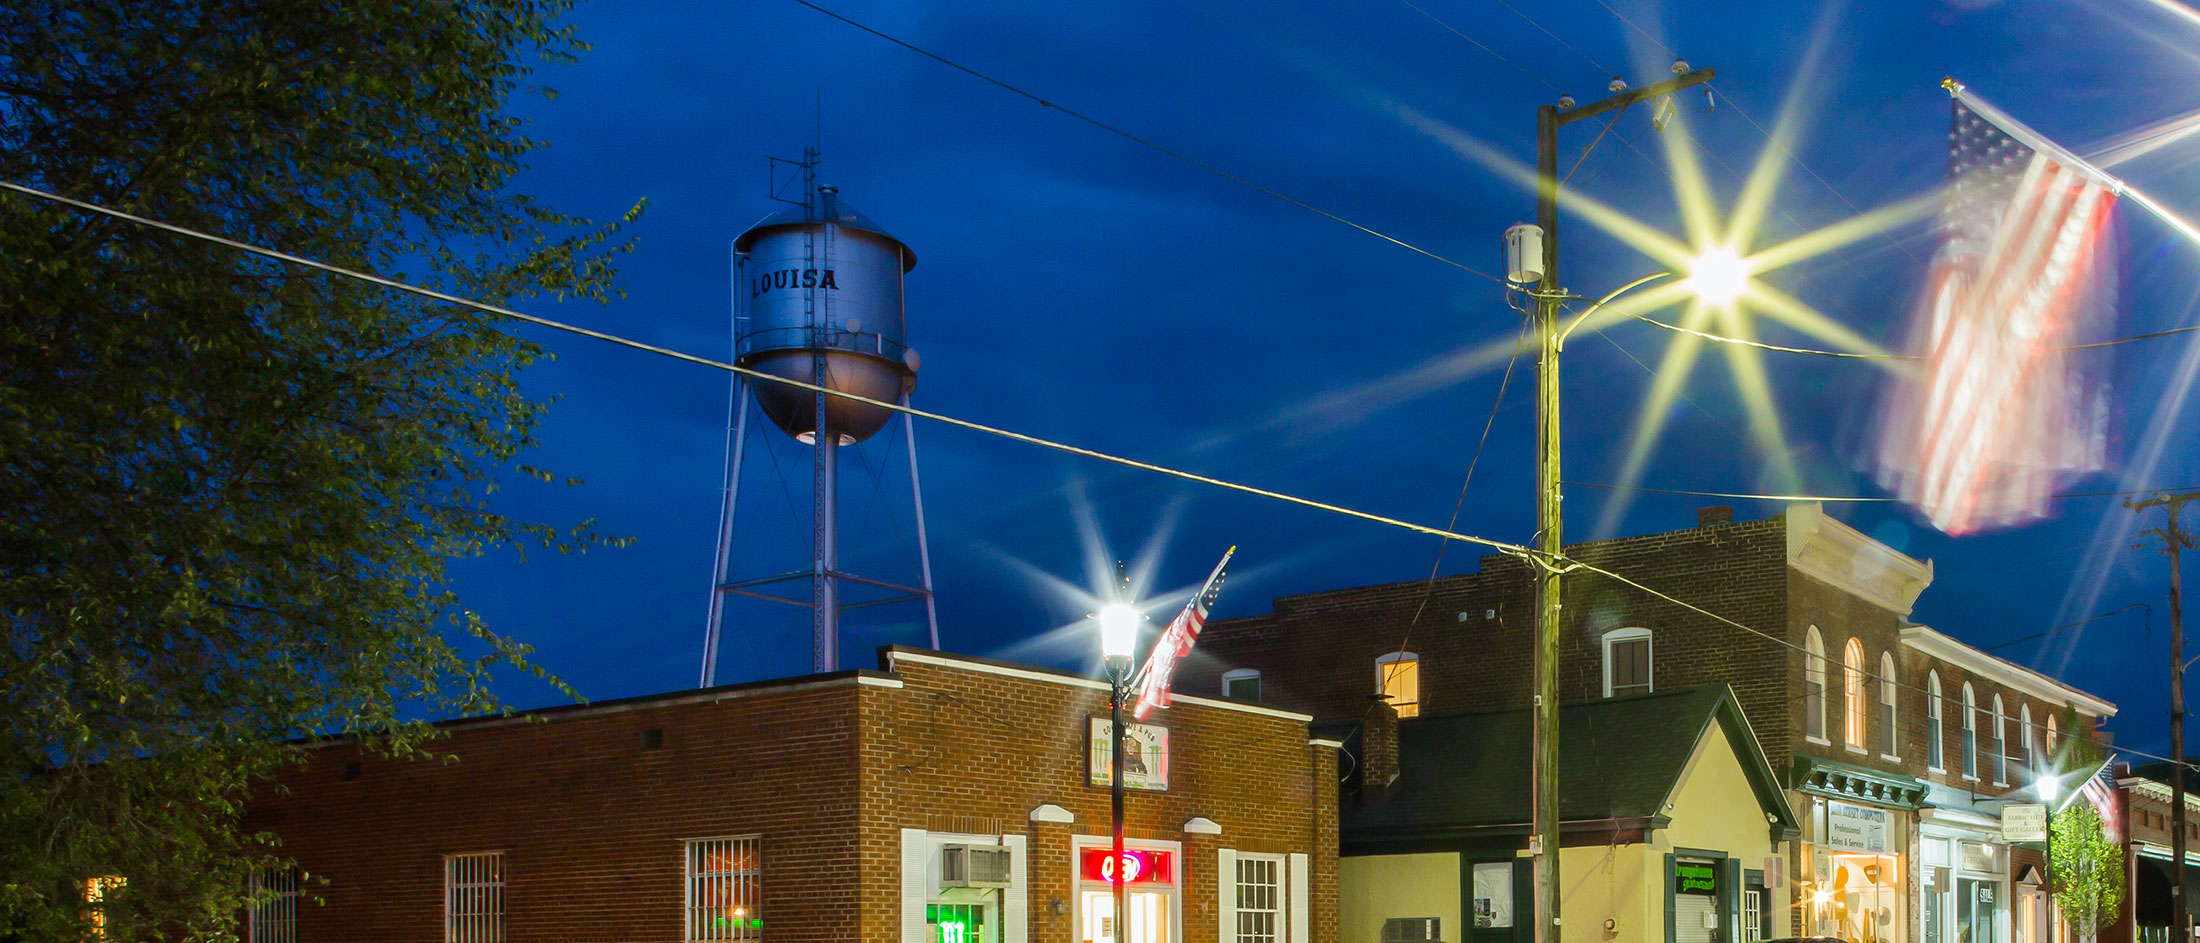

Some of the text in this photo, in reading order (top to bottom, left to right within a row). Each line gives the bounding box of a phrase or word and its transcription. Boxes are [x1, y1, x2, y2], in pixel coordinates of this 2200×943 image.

[753, 269, 839, 297] LOUISA
[1144, 729, 1156, 742] PUB
[1834, 823, 1862, 835] Professional
[1831, 836, 1864, 848] Sales & Service
[1101, 856, 1138, 881] OEN
